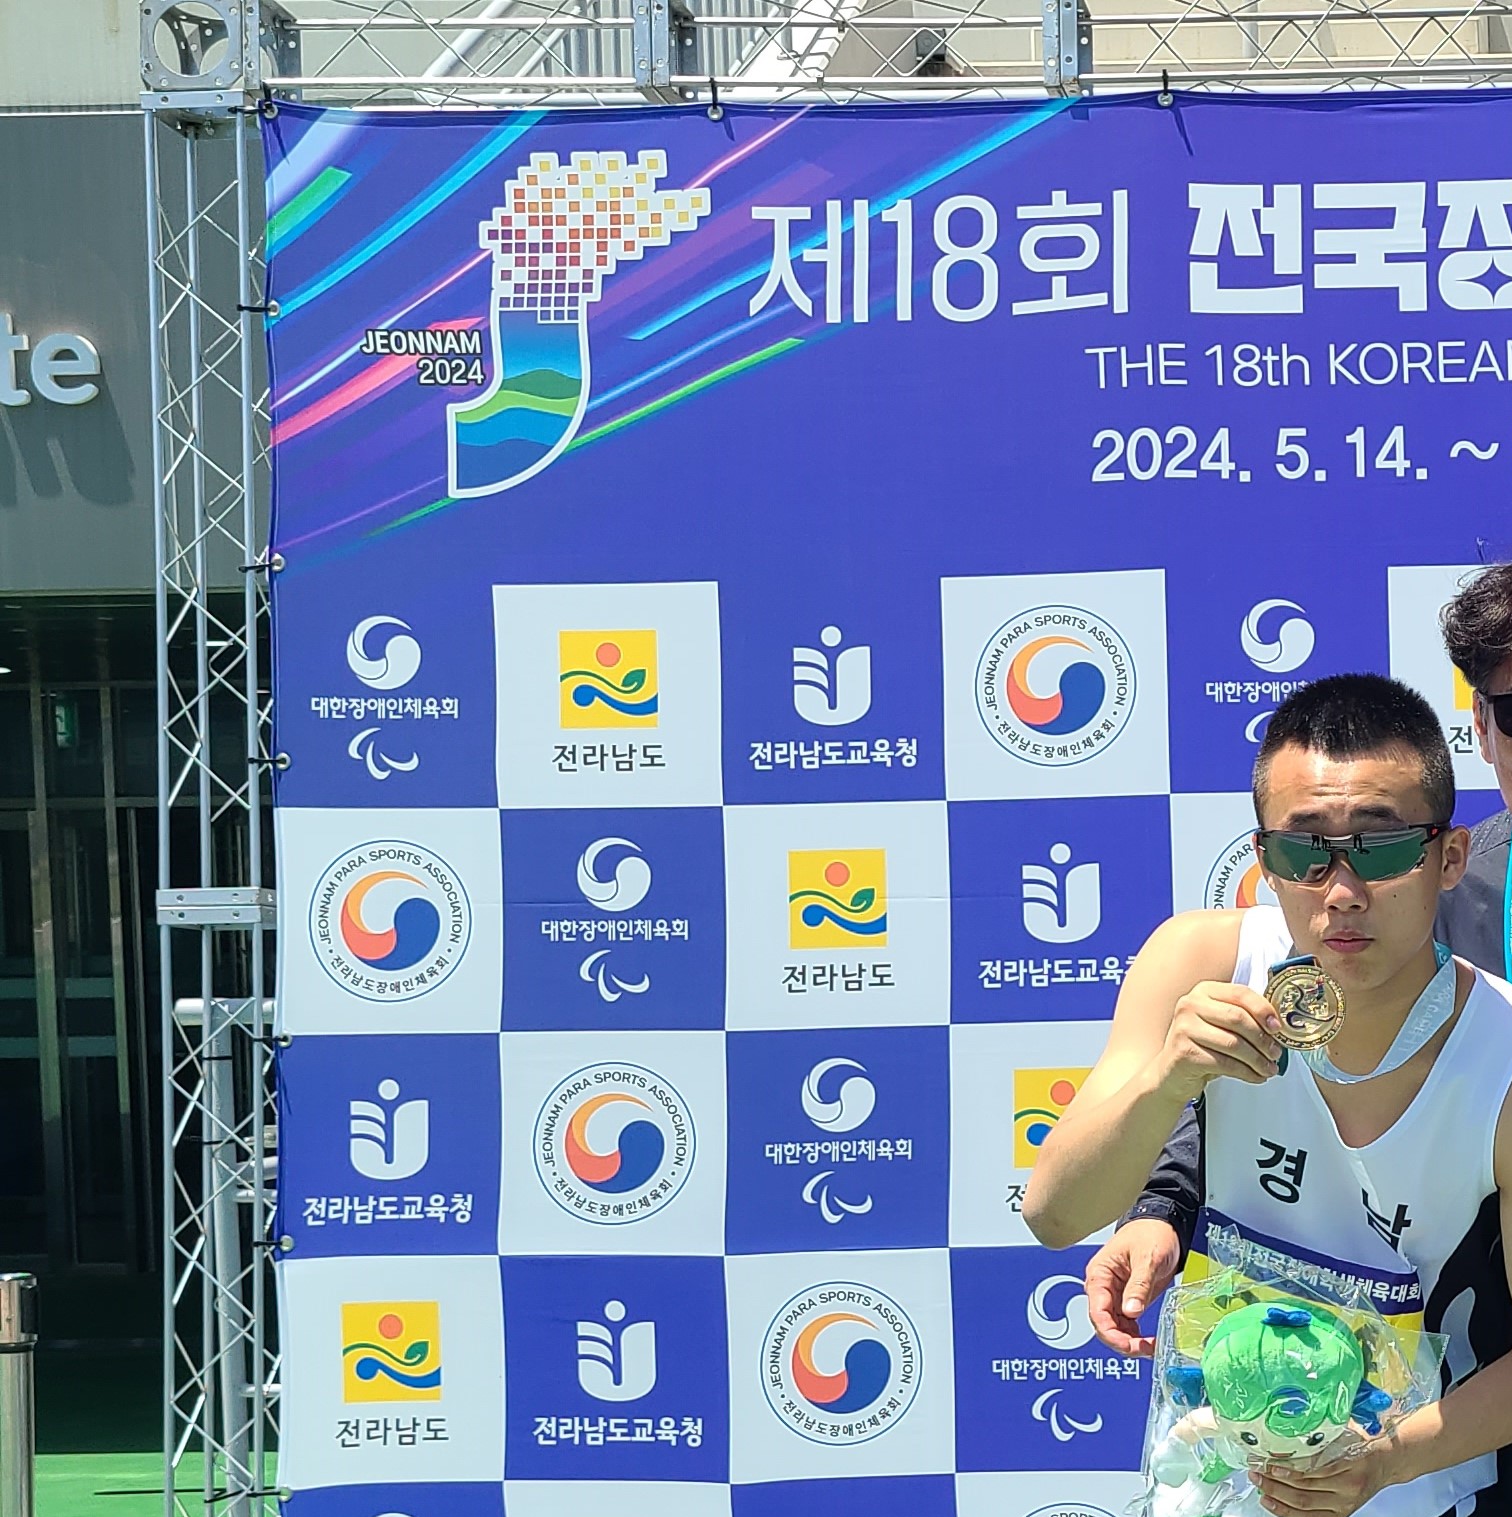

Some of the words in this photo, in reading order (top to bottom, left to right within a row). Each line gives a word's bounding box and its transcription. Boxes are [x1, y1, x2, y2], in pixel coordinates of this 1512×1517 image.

[750, 190, 1128, 323] 제18회
[361, 330, 482, 354] JEONNAM
[418, 358, 484, 384] 2024
[1085, 344, 1187, 388] THE
[1206, 344, 1309, 386] 18th
[1092, 426, 1250, 482] 2024.
[985, 649, 1003, 710] JEONNAM
[1000, 622, 1032, 648] PARA
[1035, 615, 1087, 629] SPORTS
[1088, 627, 1127, 705] ASSOCIATION
[1205, 681, 1308, 703] 대한장애인
[312, 697, 458, 719] 대한장애인체육회
[998, 719, 1115, 758] 전라남도장애인체육회
[553, 744, 665, 772] 전라남도
[750, 739, 916, 769] 전라남도교육청
[1229, 843, 1254, 866] PAR
[319, 882, 338, 944] JEONNAM
[335, 856, 366, 881] PARA
[369, 850, 421, 865] SPORTS
[423, 863, 462, 943] ASSOCIATION
[542, 919, 688, 941] 대한장애인체육회
[331, 956, 449, 993] 전라남도장애인체육회
[782, 964, 894, 993] 전라남도
[543, 1104, 563, 1166] JEONNAM
[559, 1079, 592, 1104] PARA
[594, 1072, 647, 1088] SPORTS
[648, 1085, 686, 1166] ASSOCIATION
[766, 1139, 911, 1164] 대한장애인체육회
[1256, 1137, 1308, 1204] 경
[303, 1194, 472, 1225] 전라남도교육청
[555, 1178, 672, 1216] 전라남도장애인체육회
[770, 1326, 789, 1389] JEONNAM
[785, 1299, 817, 1325] PARA
[819, 1291, 871, 1306] SPORTS
[873, 1304, 913, 1383] ASSOCIATION
[992, 1357, 1141, 1381] 대한장애인체육회
[534, 1417, 702, 1446] 전라남도교육청
[783, 1397, 901, 1437] 전라남도장애인체육회
[336, 1418, 448, 1447] 전라남도
